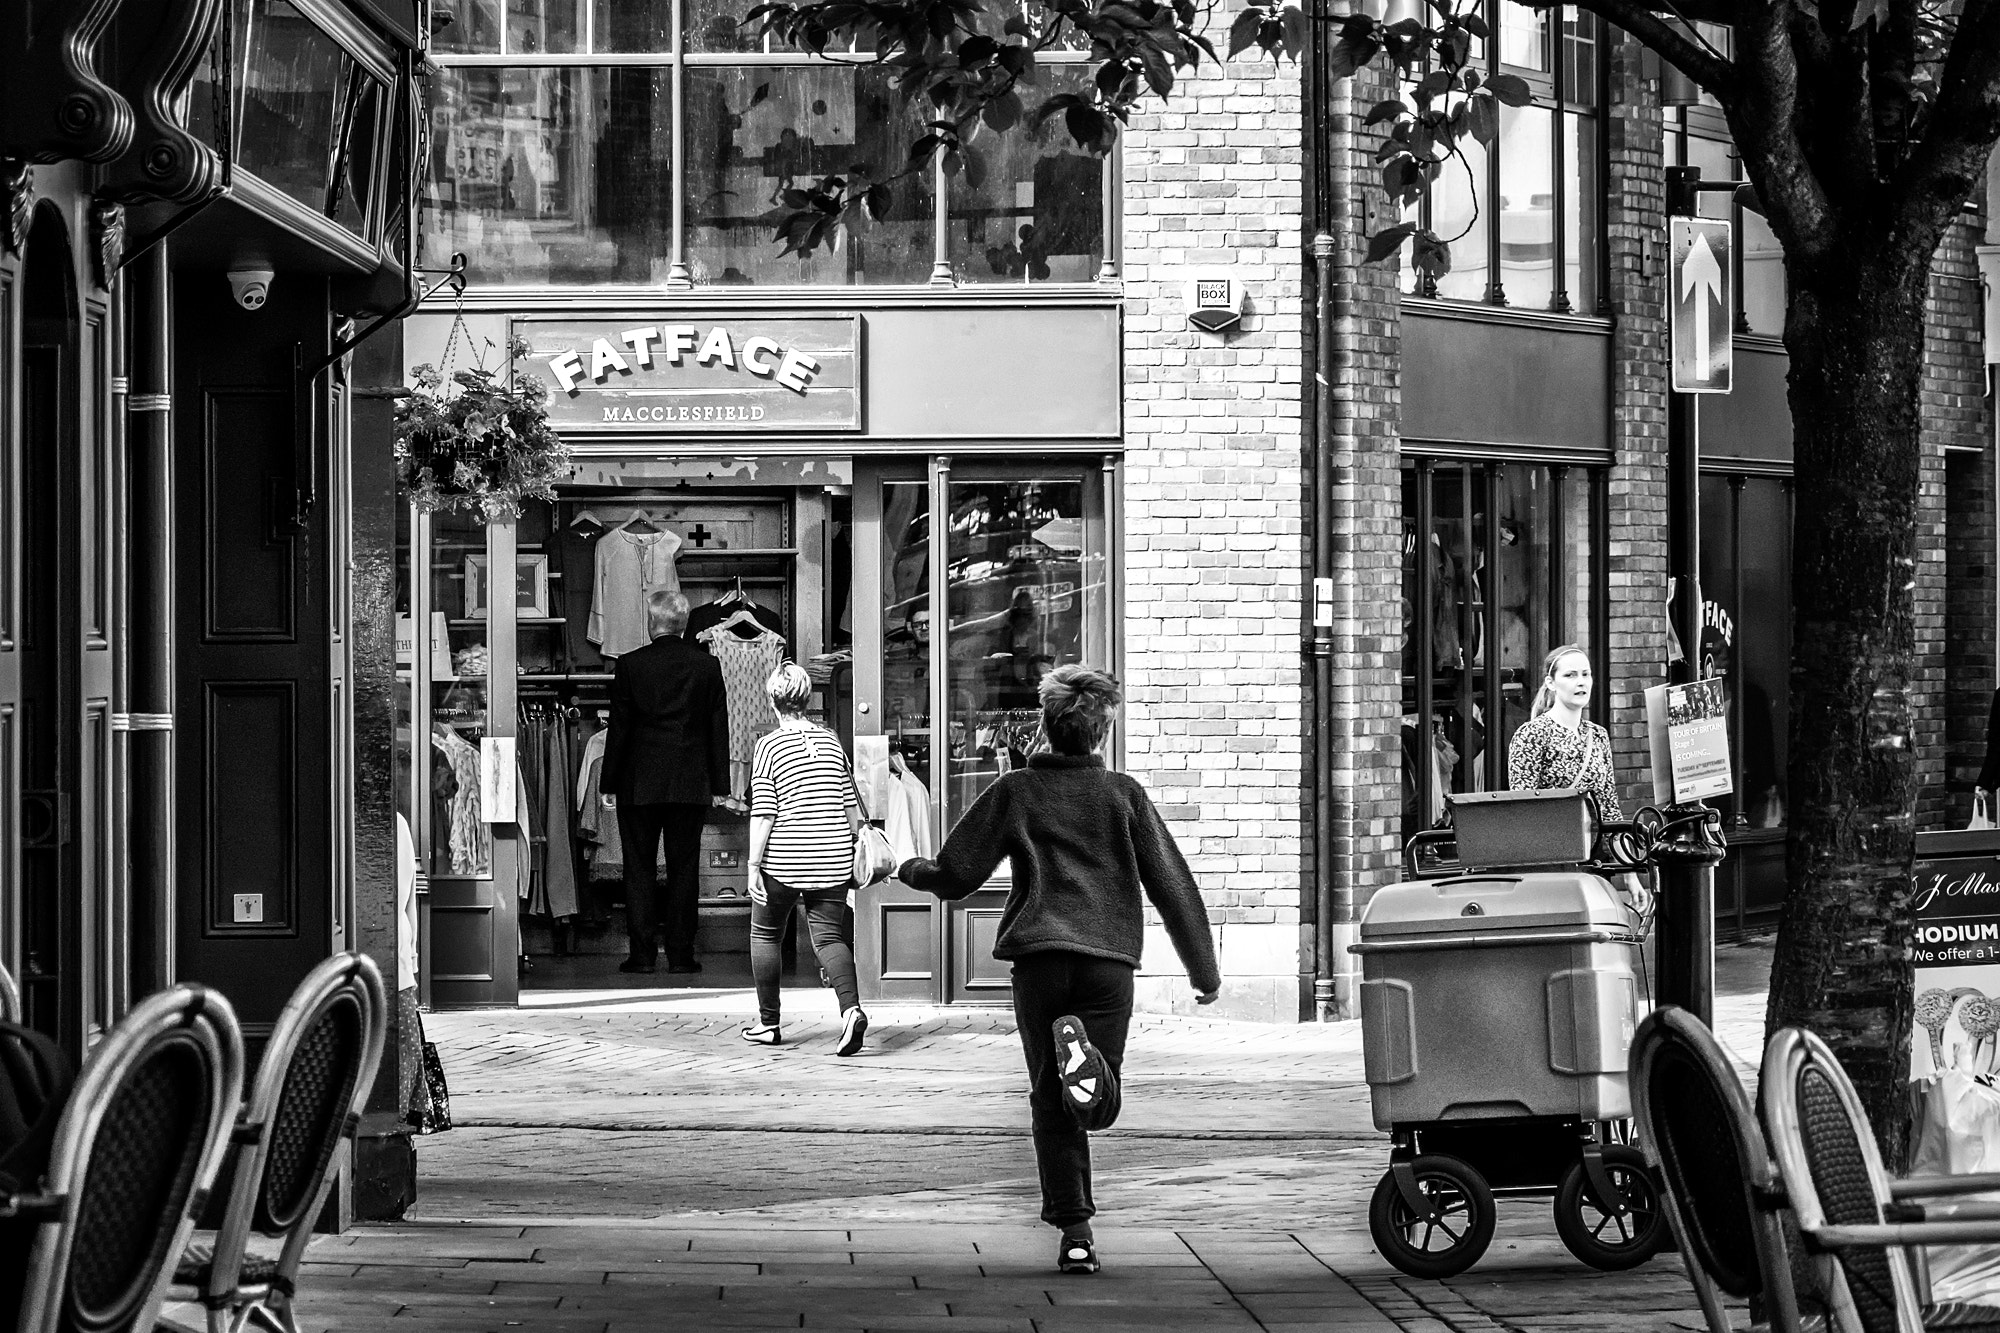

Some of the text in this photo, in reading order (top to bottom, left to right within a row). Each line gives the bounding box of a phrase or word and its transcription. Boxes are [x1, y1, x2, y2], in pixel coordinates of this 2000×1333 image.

[1201, 290, 1226, 299] BOX
[548, 324, 818, 394] FATFACE
[602, 405, 765, 422] MACCLESFIELD
[1673, 722, 1723, 739] TOUR OF BRITAIN
[1675, 753, 1682, 762] IS
[1937, 947, 1972, 961] offer
[1976, 948, 1985, 959] a
